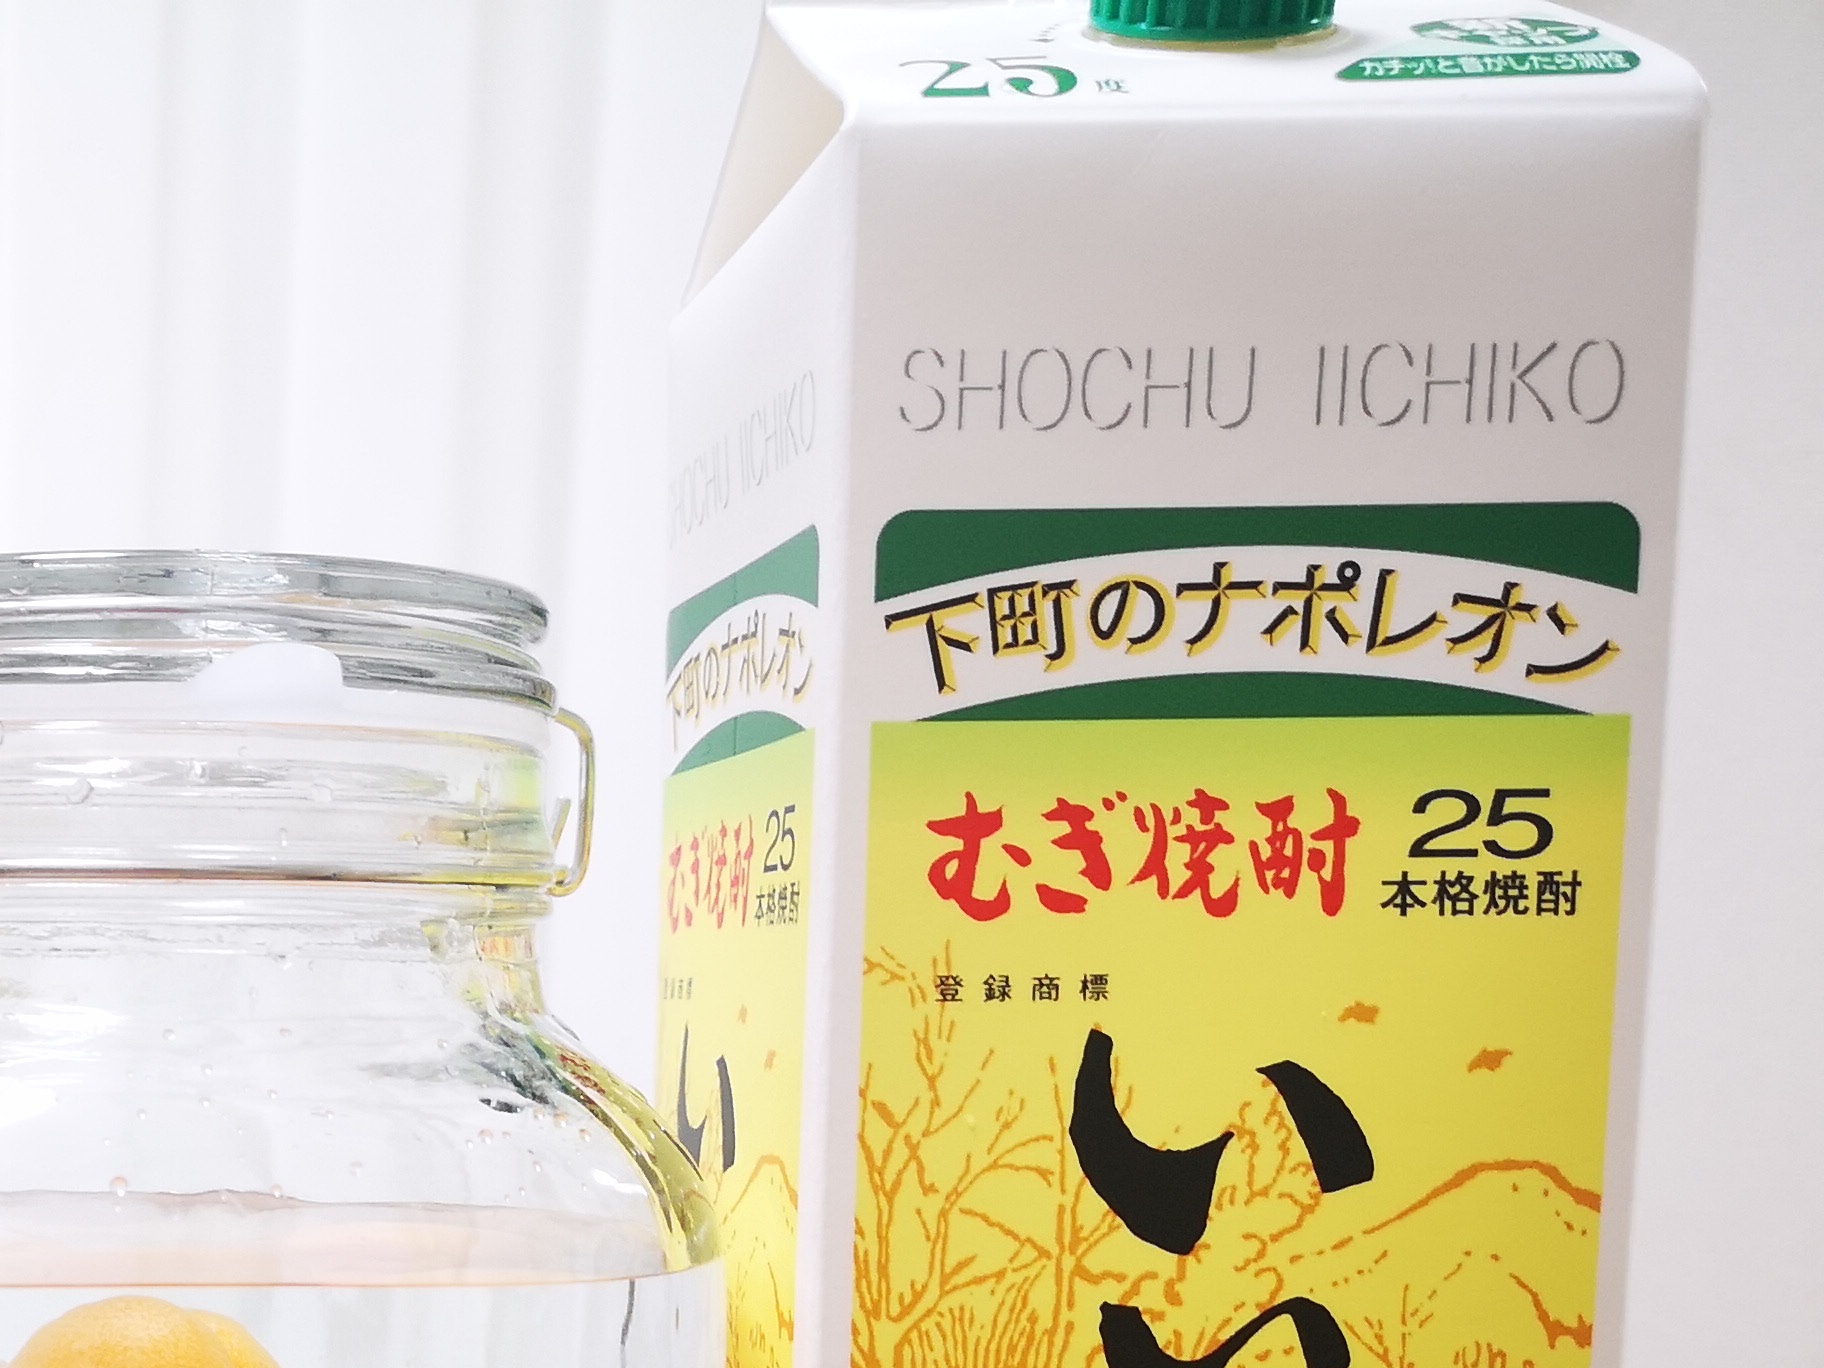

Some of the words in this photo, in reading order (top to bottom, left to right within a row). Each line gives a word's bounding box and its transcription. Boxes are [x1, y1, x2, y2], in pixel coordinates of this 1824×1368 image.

[898, 55, 1079, 98] 25
[898, 345, 1257, 432] SHOCHU
[1314, 338, 1626, 427] IICHIKO
[739, 369, 816, 496] IICHIKO
[884, 558, 1623, 696] 下町のナポレオン
[665, 608, 813, 753] 下町のナポレオン
[762, 804, 796, 873] 25
[926, 787, 1360, 922] むぎ焼酎
[1407, 787, 1555, 861] 25
[1380, 869, 1583, 918] 本格焼酎
[933, 973, 1112, 1003] 登録商標
